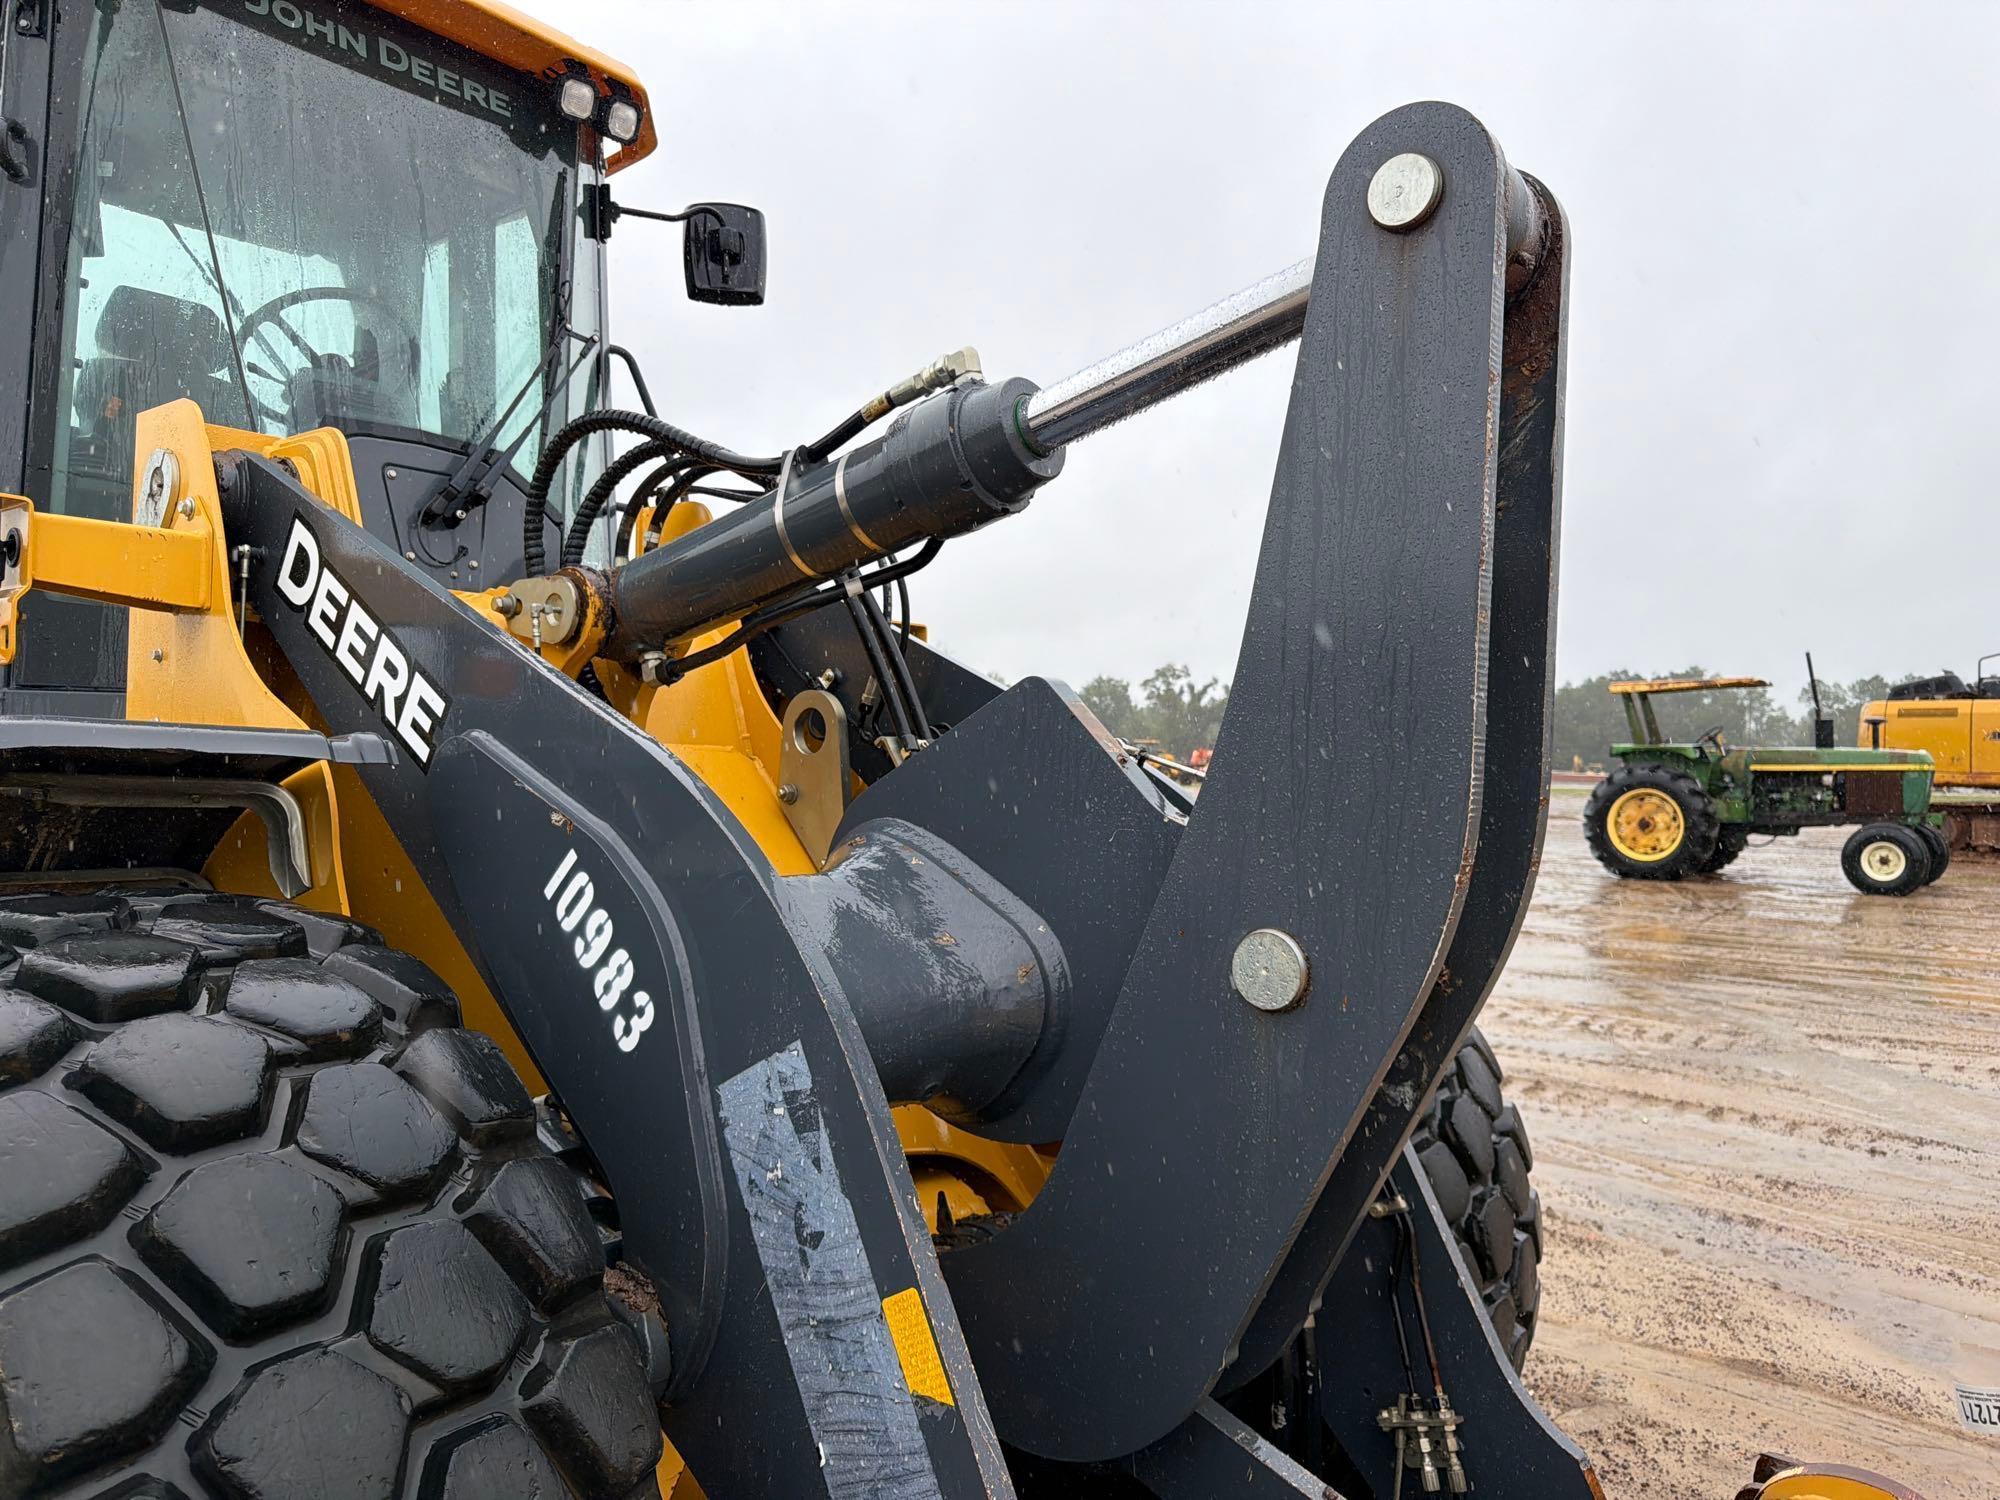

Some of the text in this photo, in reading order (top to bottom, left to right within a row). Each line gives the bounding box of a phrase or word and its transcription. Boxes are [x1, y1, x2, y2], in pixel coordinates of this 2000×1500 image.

[245, 0, 512, 118] JOHN DEERE
[276, 517, 446, 764] DEERE
[543, 848, 655, 1053] 10983
